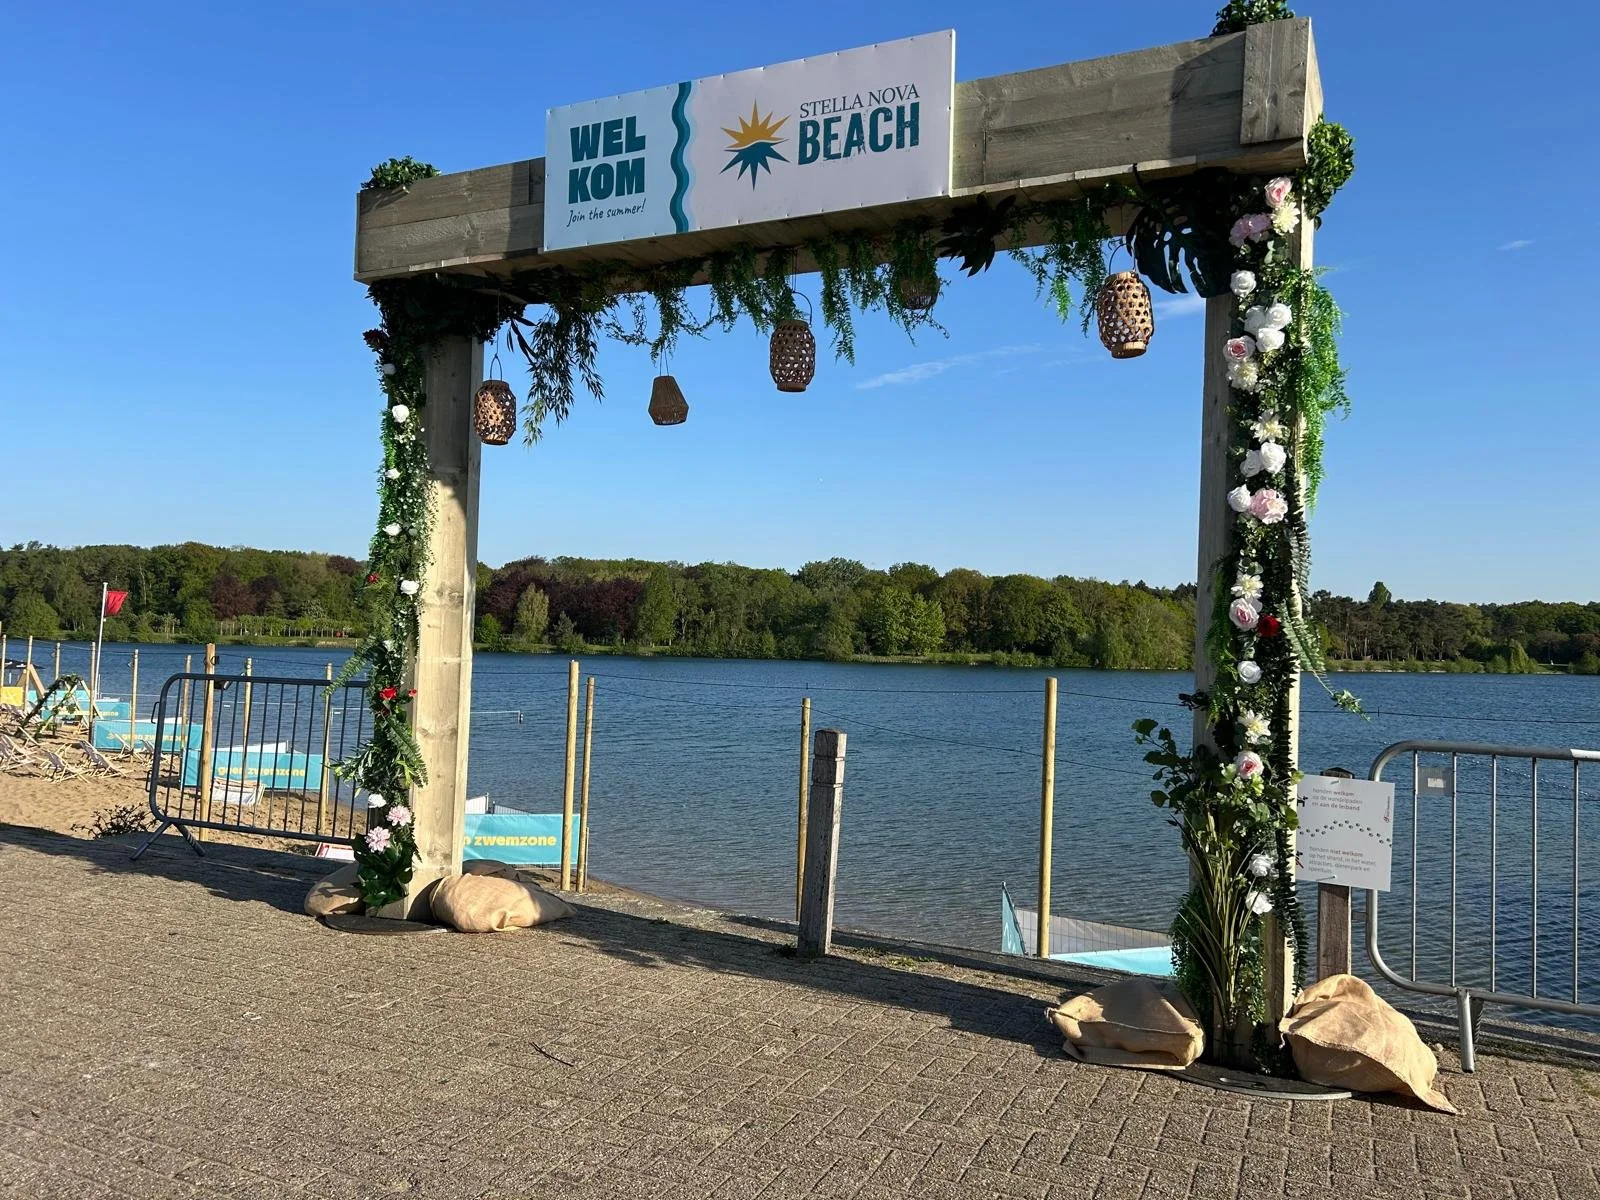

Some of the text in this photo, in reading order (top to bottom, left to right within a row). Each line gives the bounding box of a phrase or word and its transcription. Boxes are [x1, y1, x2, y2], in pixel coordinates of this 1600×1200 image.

[800, 83, 920, 119] STELLA NOVA
[570, 116, 646, 162] WEL
[798, 101, 920, 165] BEACH
[568, 157, 645, 204] KOM
[566, 198, 646, 227] Join the summer!
[474, 836, 557, 846] zwemzone
